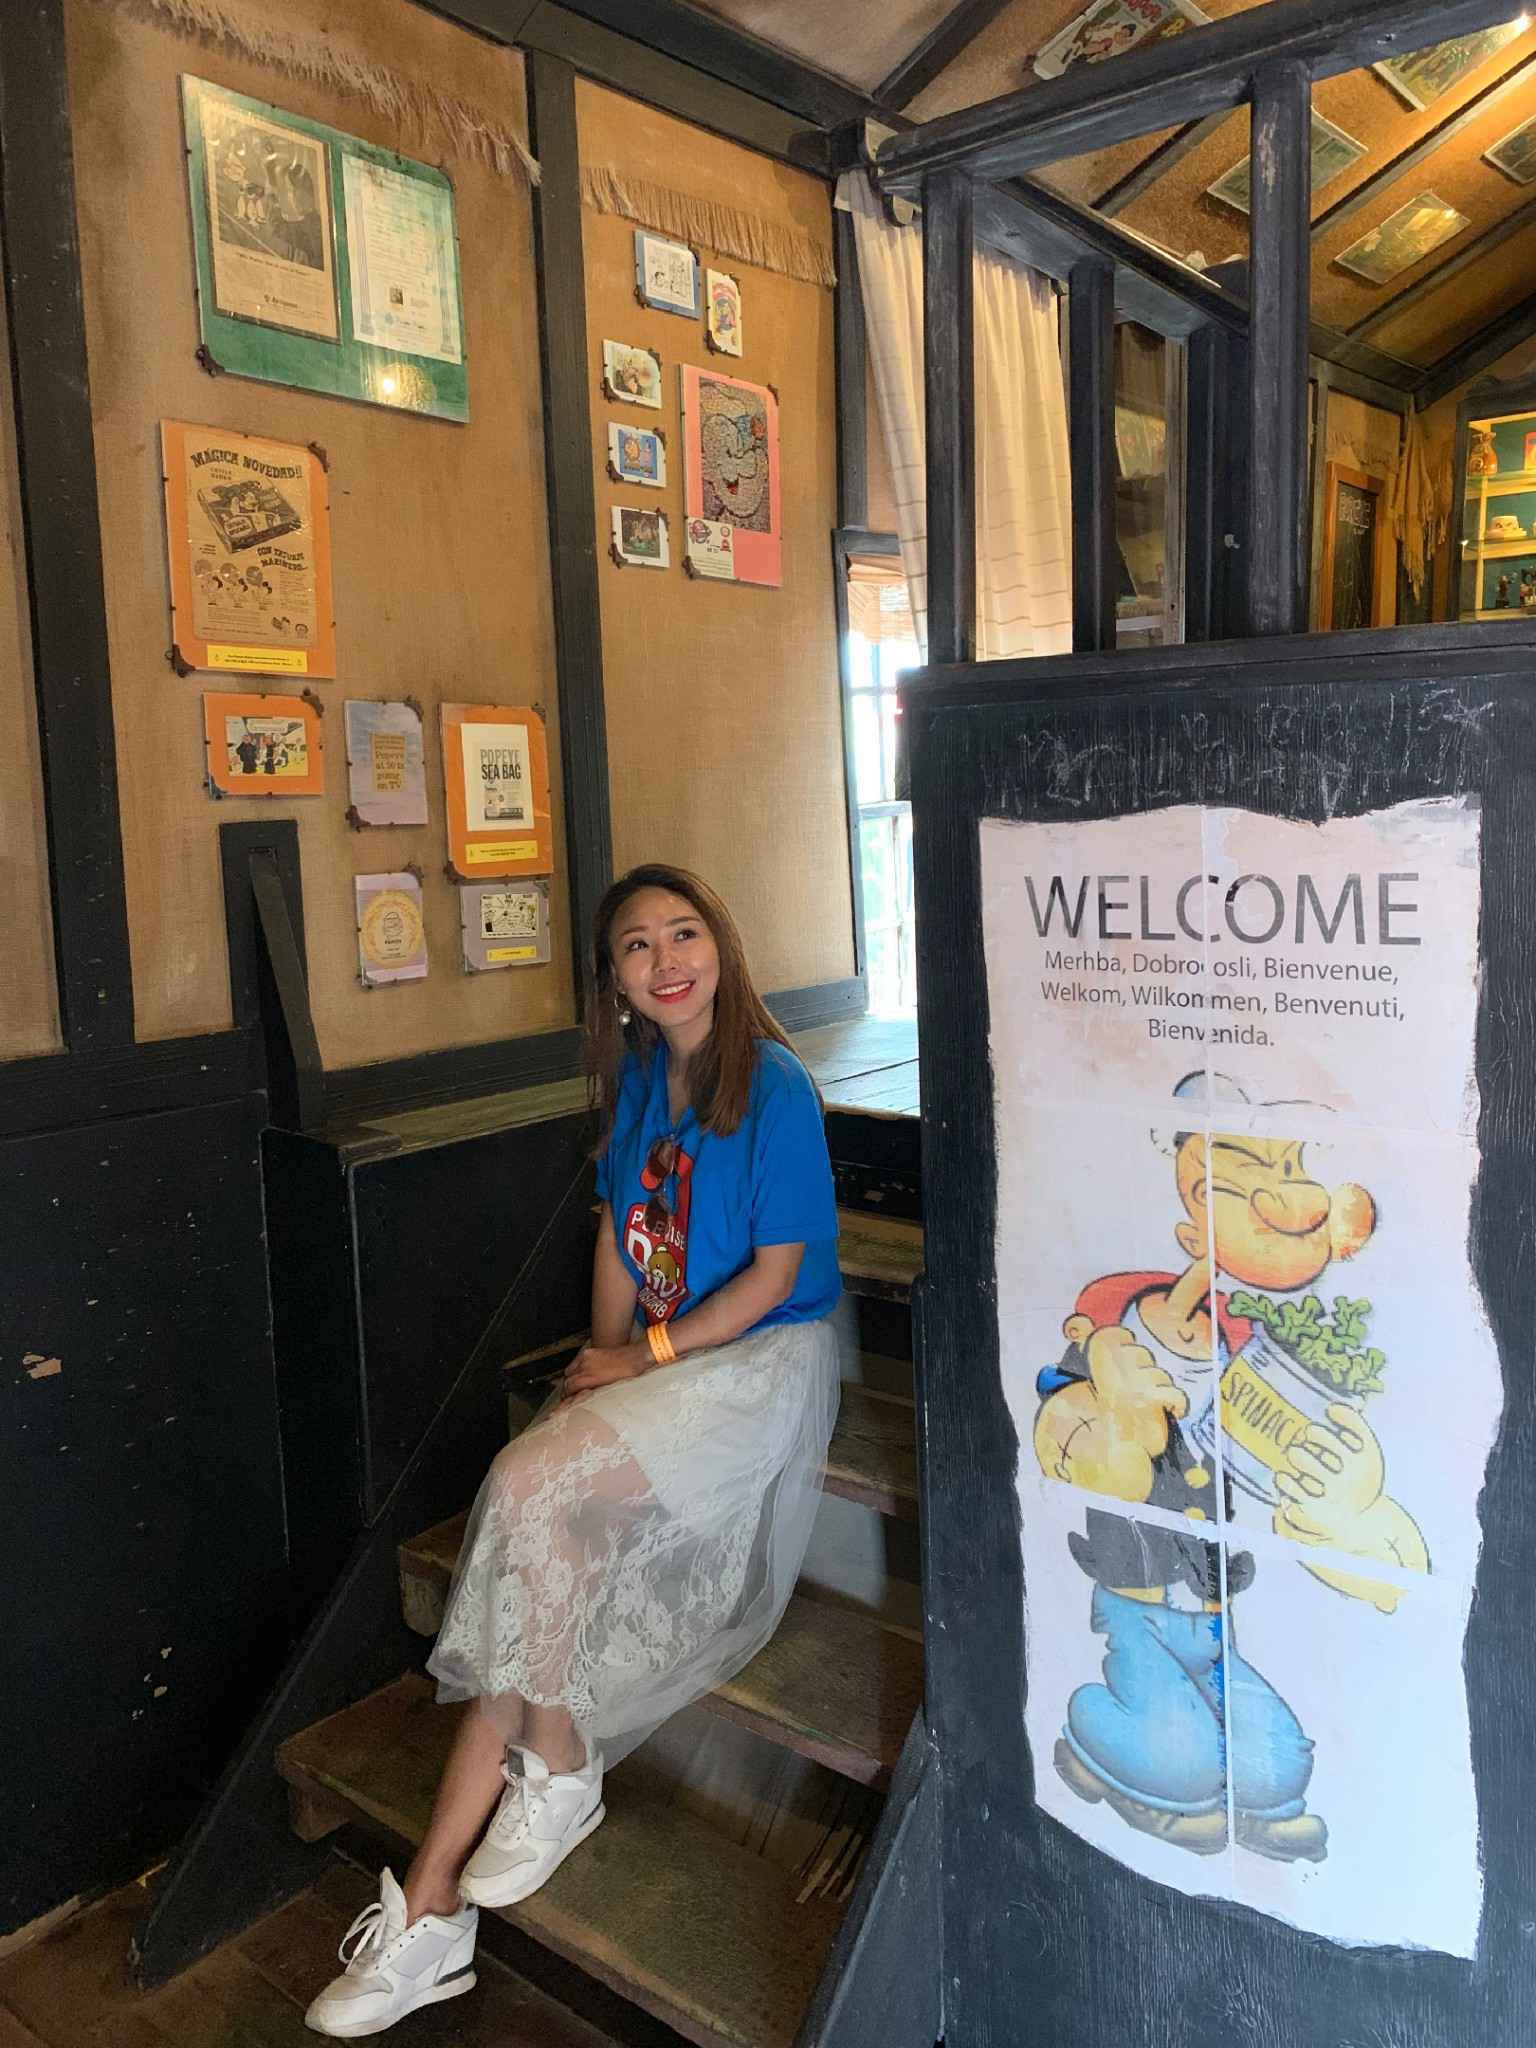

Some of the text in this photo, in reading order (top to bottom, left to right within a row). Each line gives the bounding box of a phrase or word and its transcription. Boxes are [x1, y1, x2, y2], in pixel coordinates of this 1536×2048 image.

[480, 749, 520, 764] POPEYE
[482, 764, 521, 781] SEA BAG
[1023, 872, 1422, 946] WELCOME
[1044, 950, 1399, 985] Merhba, Dobroosli, Bienvenue,
[1039, 980, 1127, 1007] Welkom,
[1274, 992, 1406, 1022] Benvenuti,
